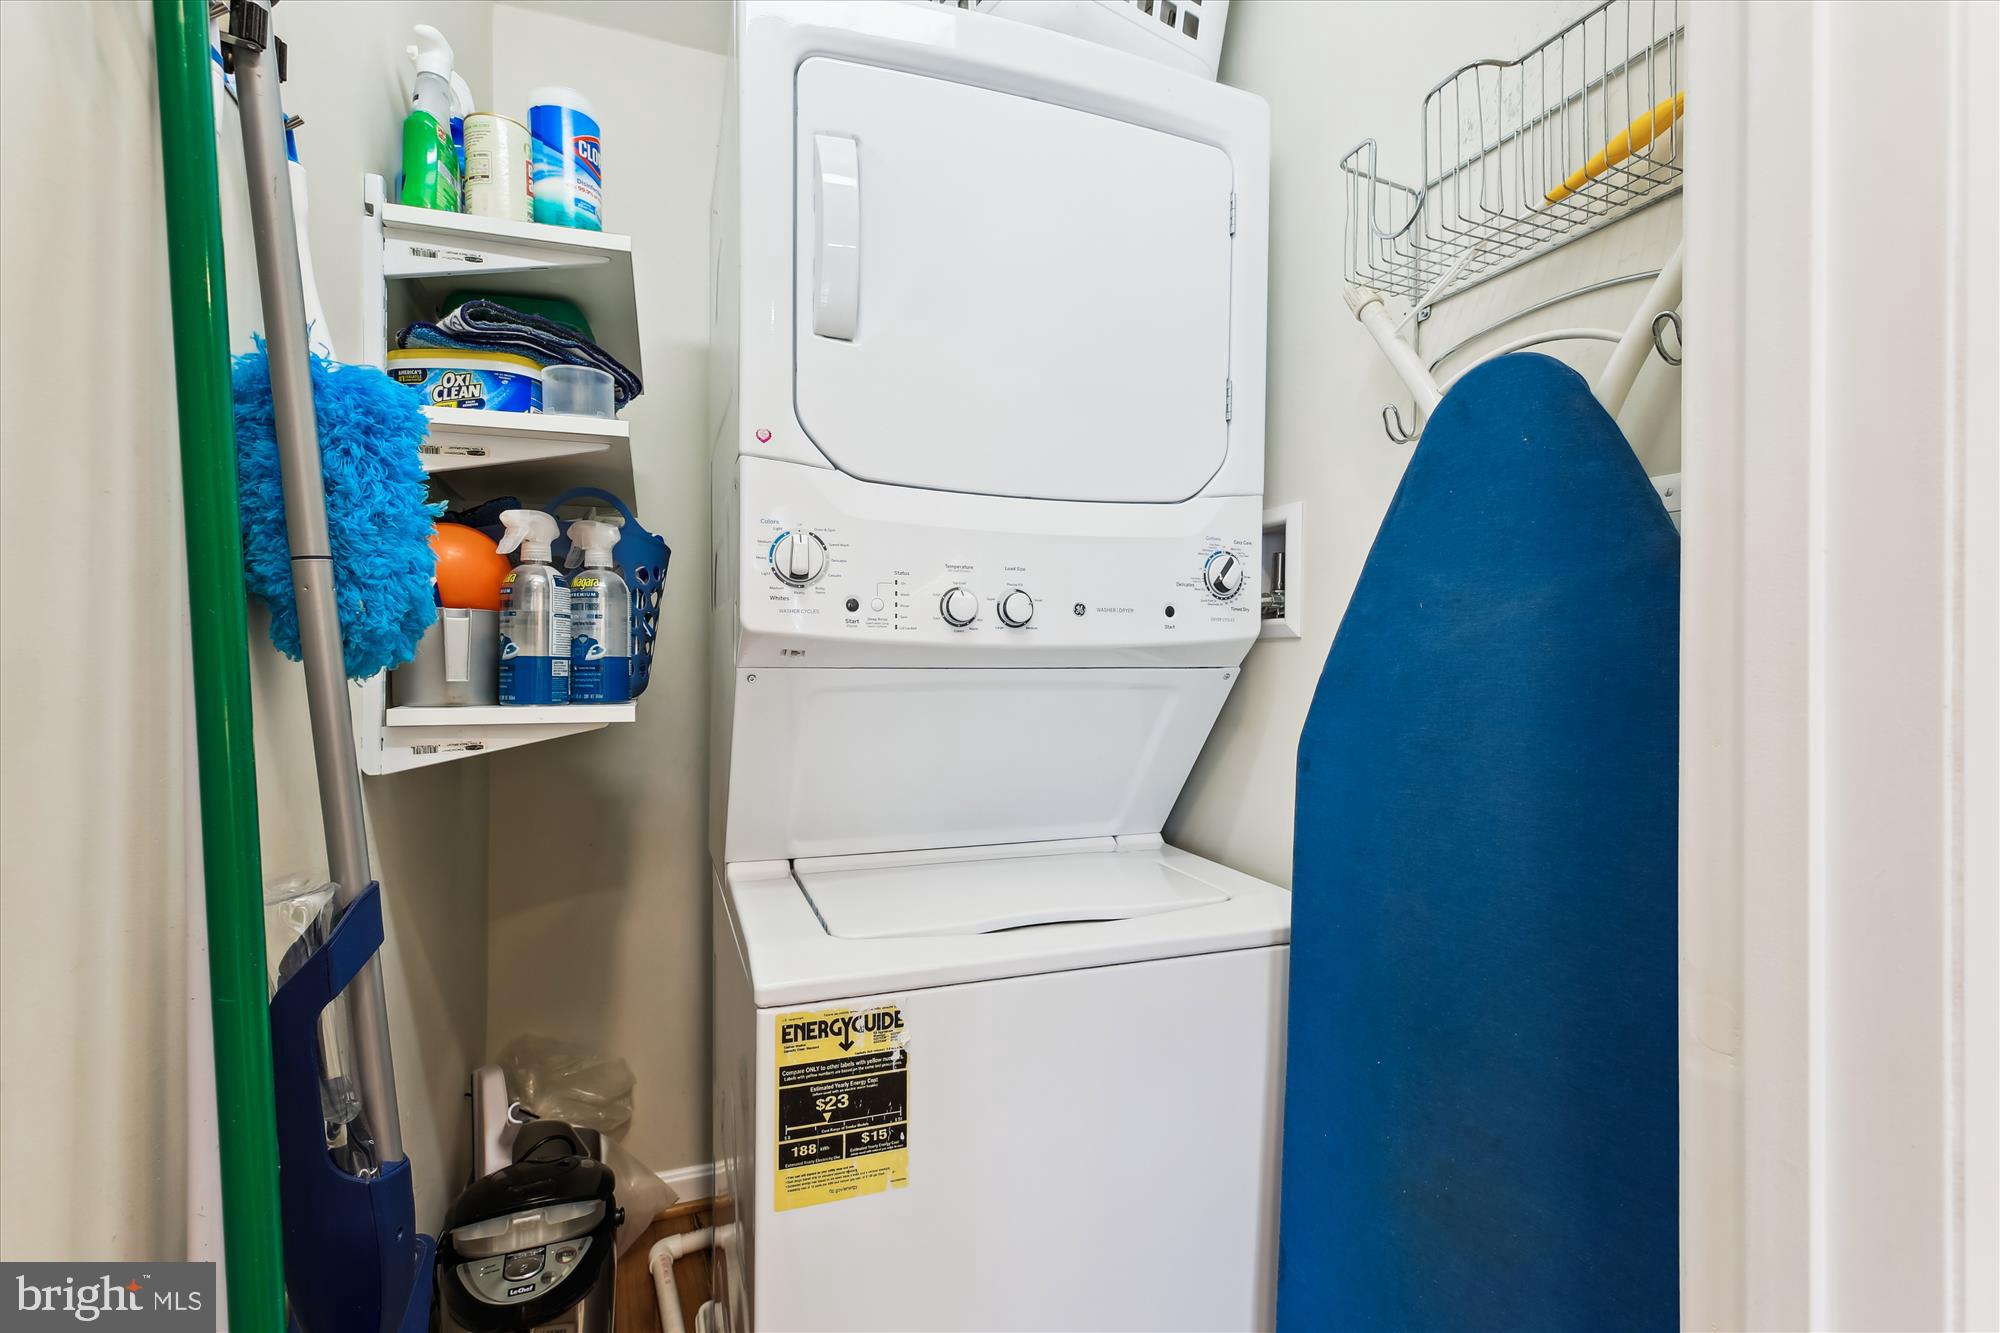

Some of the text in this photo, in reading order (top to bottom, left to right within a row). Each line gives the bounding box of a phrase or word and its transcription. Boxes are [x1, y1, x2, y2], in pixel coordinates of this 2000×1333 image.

[578, 140, 601, 168] CLO
[442, 371, 472, 388] OXI
[432, 383, 482, 402] CLEAN
[781, 1066, 805, 1077] Compare
[805, 1065, 820, 1074] ONLY
[826, 1062, 840, 1071] other
[840, 1061, 856, 1069] labels
[866, 1057, 883, 1066] yellow
[810, 1082, 834, 1093] Estimated
[834, 1081, 849, 1090] Yearly
[850, 1079, 867, 1088] Energy
[815, 1093, 849, 1111] $23
[861, 1129, 888, 1144] $15
[791, 1143, 817, 1157] 188
[784, 1160, 804, 1168] Estimated
[510, 1284, 534, 1296] LeChef
